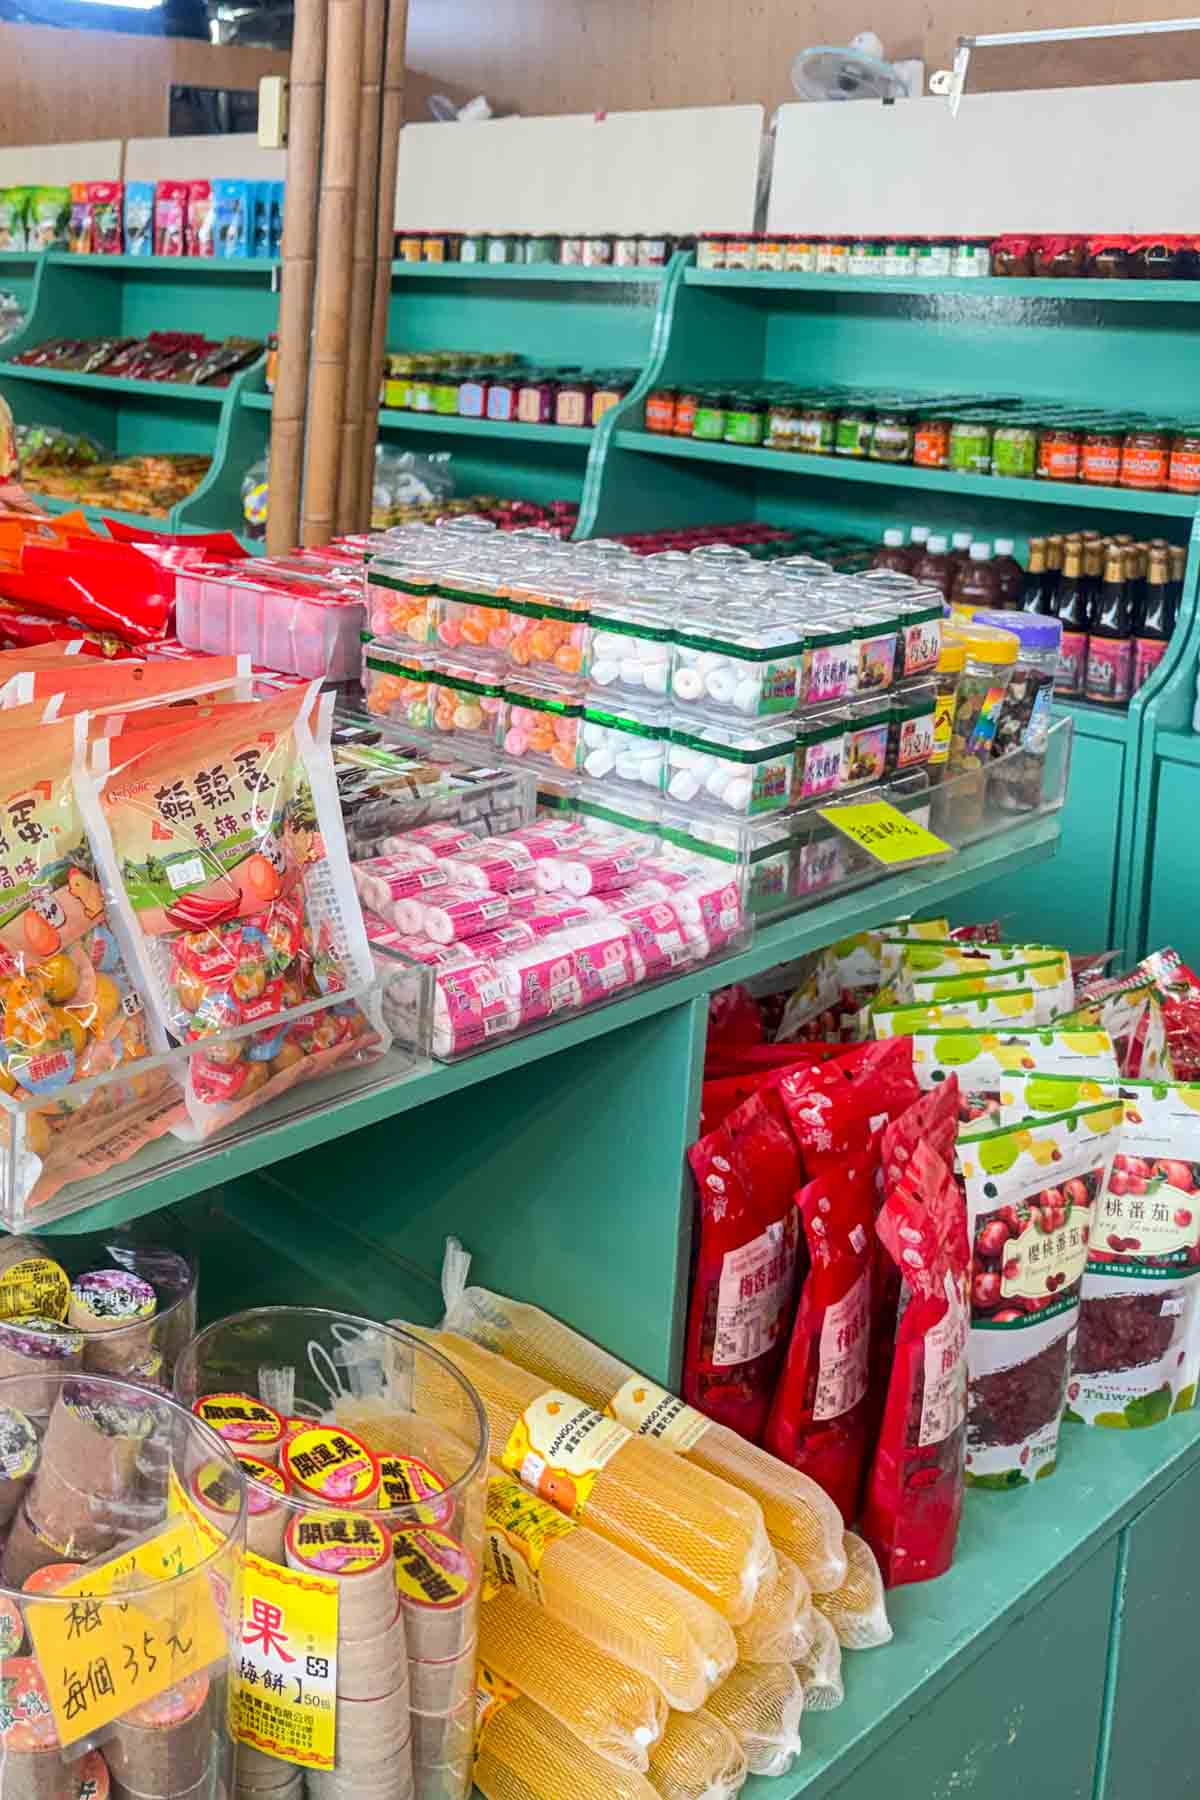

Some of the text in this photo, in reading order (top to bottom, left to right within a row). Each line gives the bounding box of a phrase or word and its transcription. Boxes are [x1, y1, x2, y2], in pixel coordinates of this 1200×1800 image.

[152, 747, 277, 825] 鵪鶉蛋
[192, 804, 269, 850] 香辣味
[1104, 1198, 1170, 1222] 桃番茄
[203, 1404, 276, 1424] 開運果
[290, 1435, 361, 1479] 開運果
[548, 1421, 575, 1457] MANGO
[297, 1519, 380, 1546] 開運果
[392, 1536, 459, 1602] 開運果
[242, 1597, 296, 1664] 果
